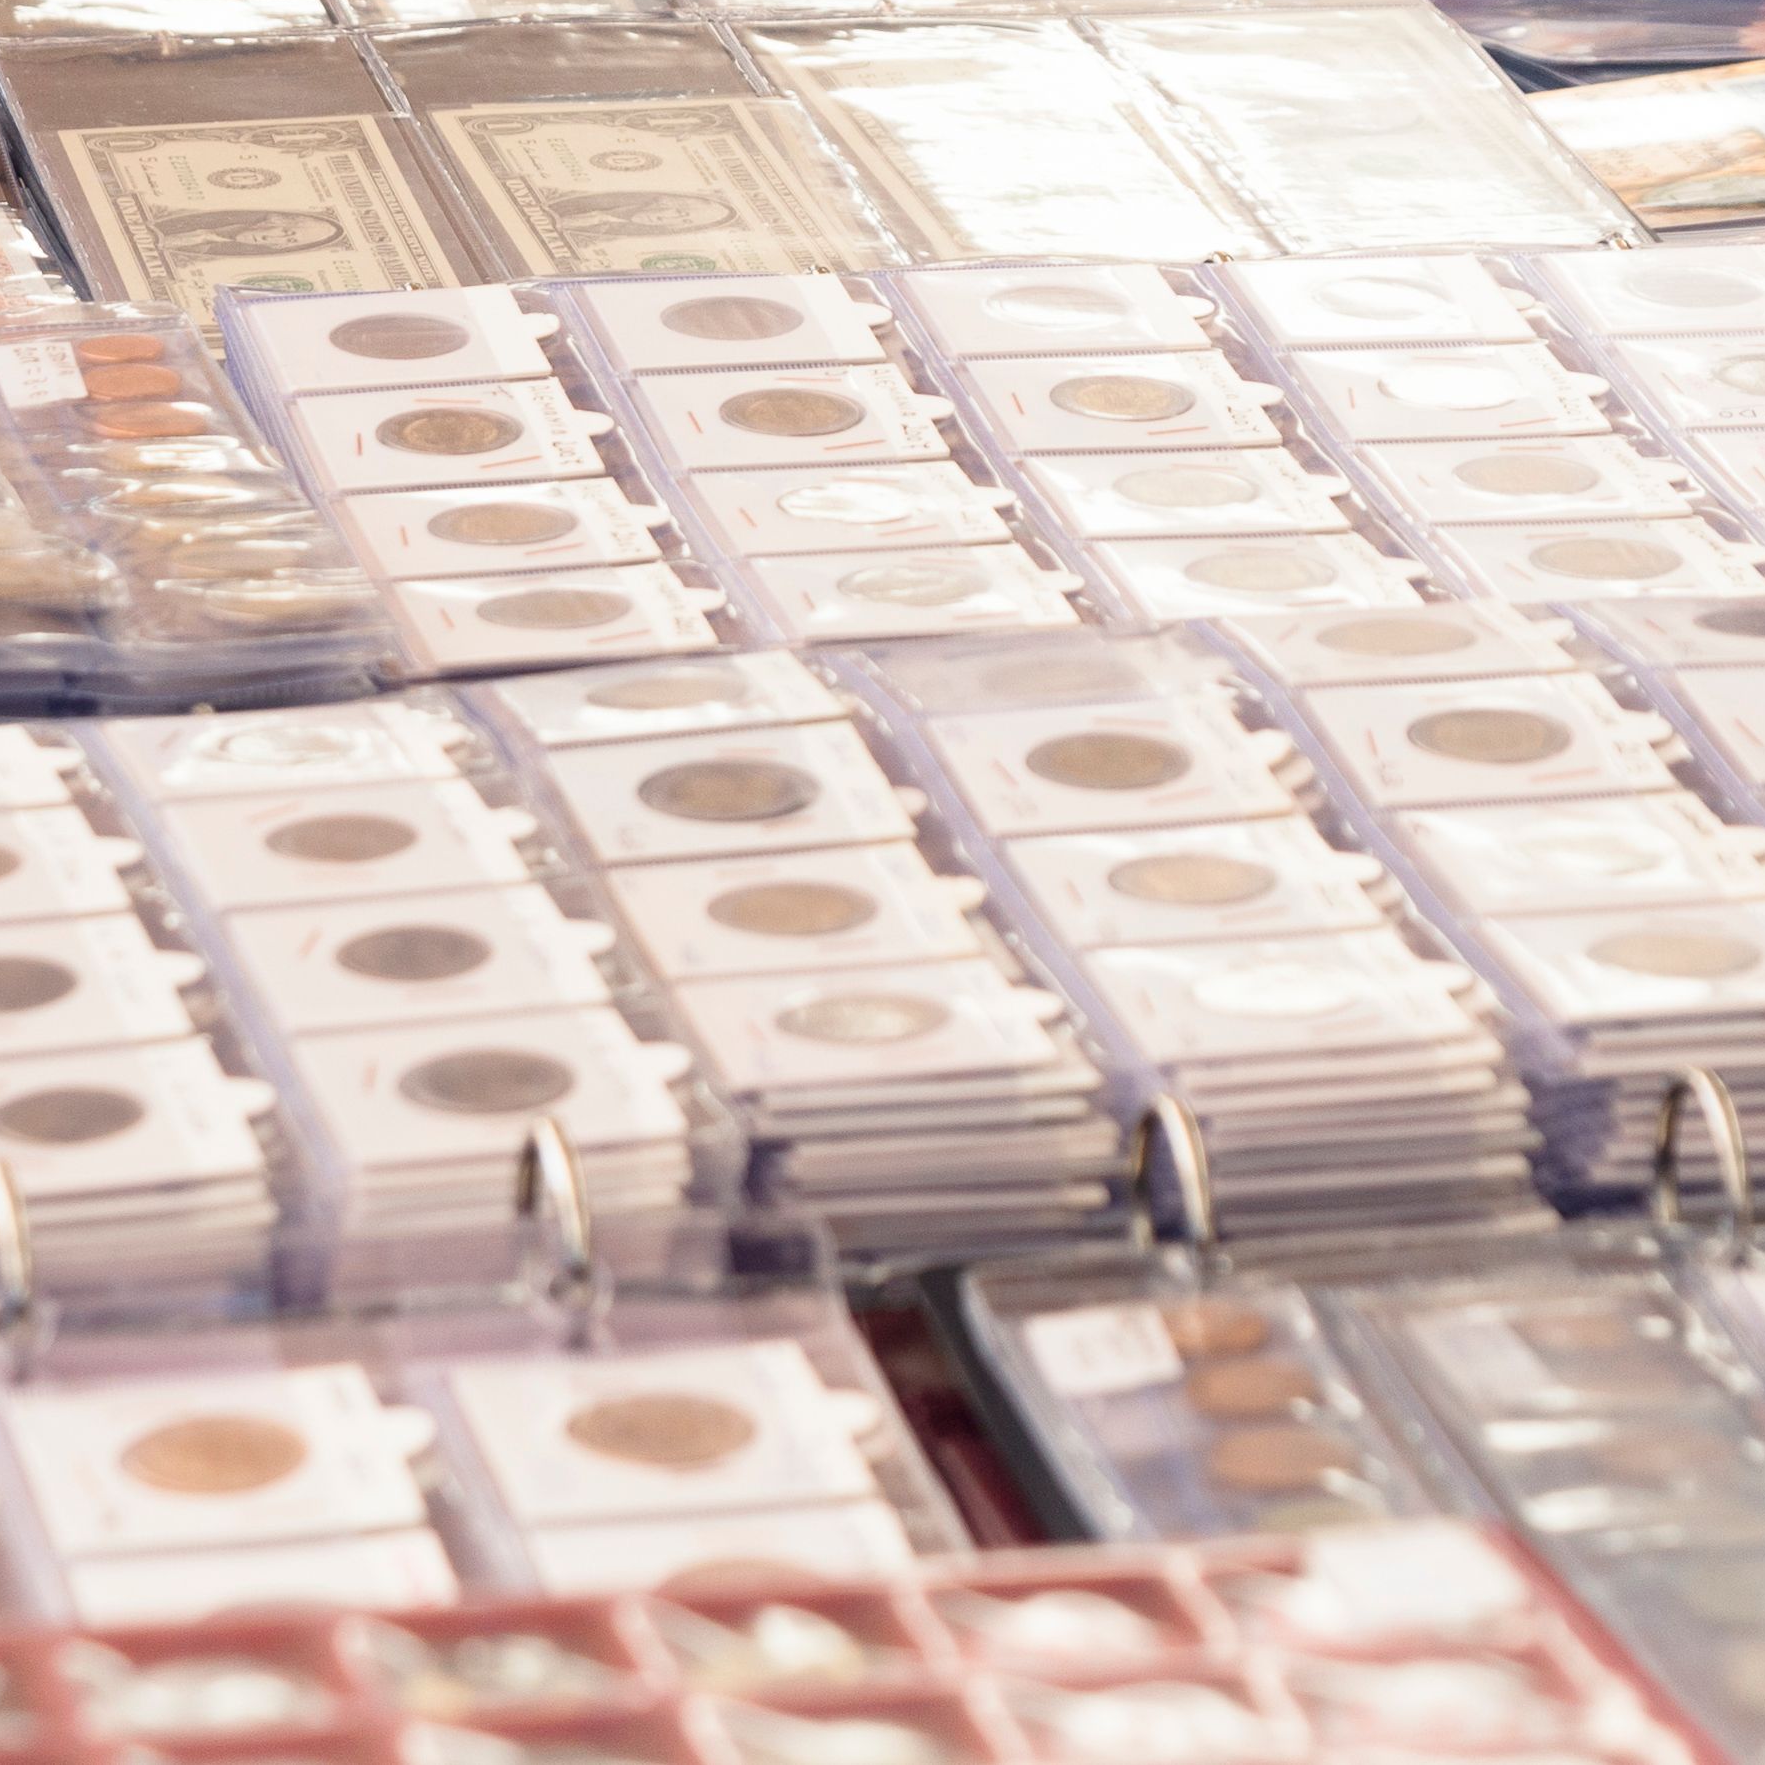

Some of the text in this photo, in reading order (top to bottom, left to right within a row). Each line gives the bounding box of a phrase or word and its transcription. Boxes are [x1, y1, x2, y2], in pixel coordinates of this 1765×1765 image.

[328, 154, 356, 174] THE
[338, 174, 374, 208] UNITED
[719, 157, 764, 191] UNITED
[743, 191, 788, 223] STATES
[115, 196, 168, 277] ONE DOLLAR
[355, 208, 391, 242] STATES
[500, 179, 577, 258] ONE DOLLAR
